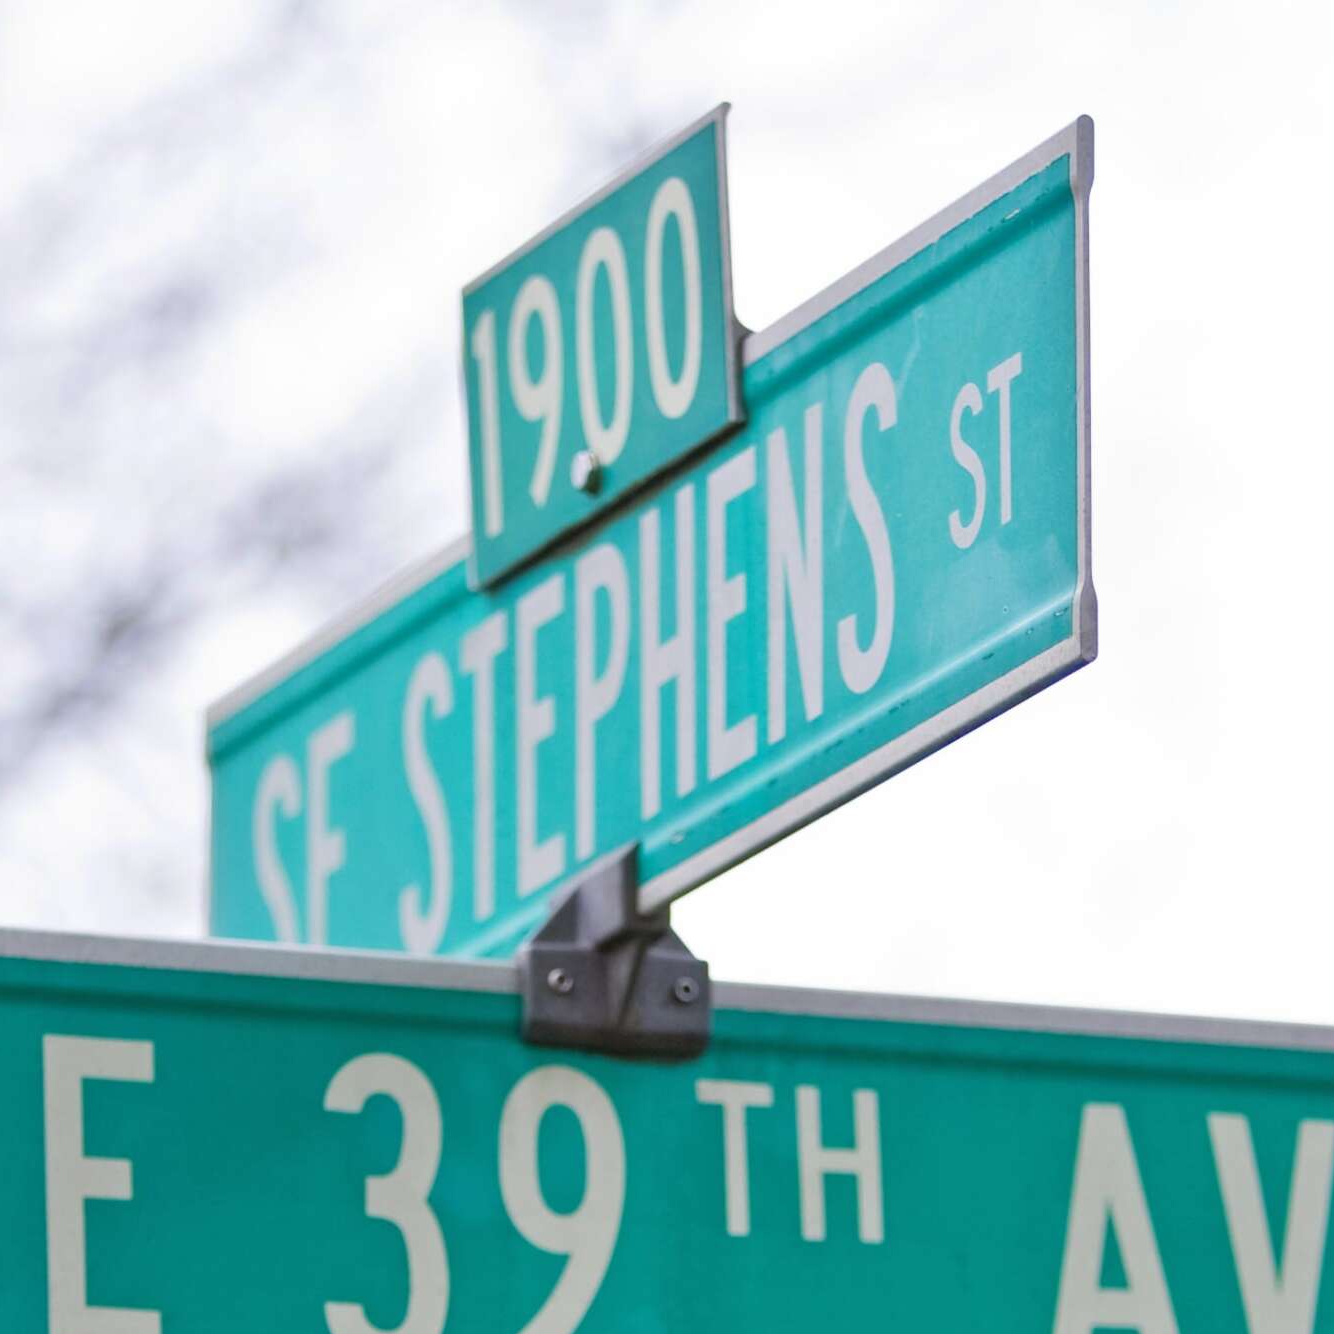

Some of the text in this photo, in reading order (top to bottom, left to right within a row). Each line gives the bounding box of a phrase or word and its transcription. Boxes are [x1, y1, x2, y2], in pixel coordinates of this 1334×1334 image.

[470, 175, 702, 538] 1900
[398, 361, 898, 955] STEPHENS
[948, 351, 1023, 550] ST
